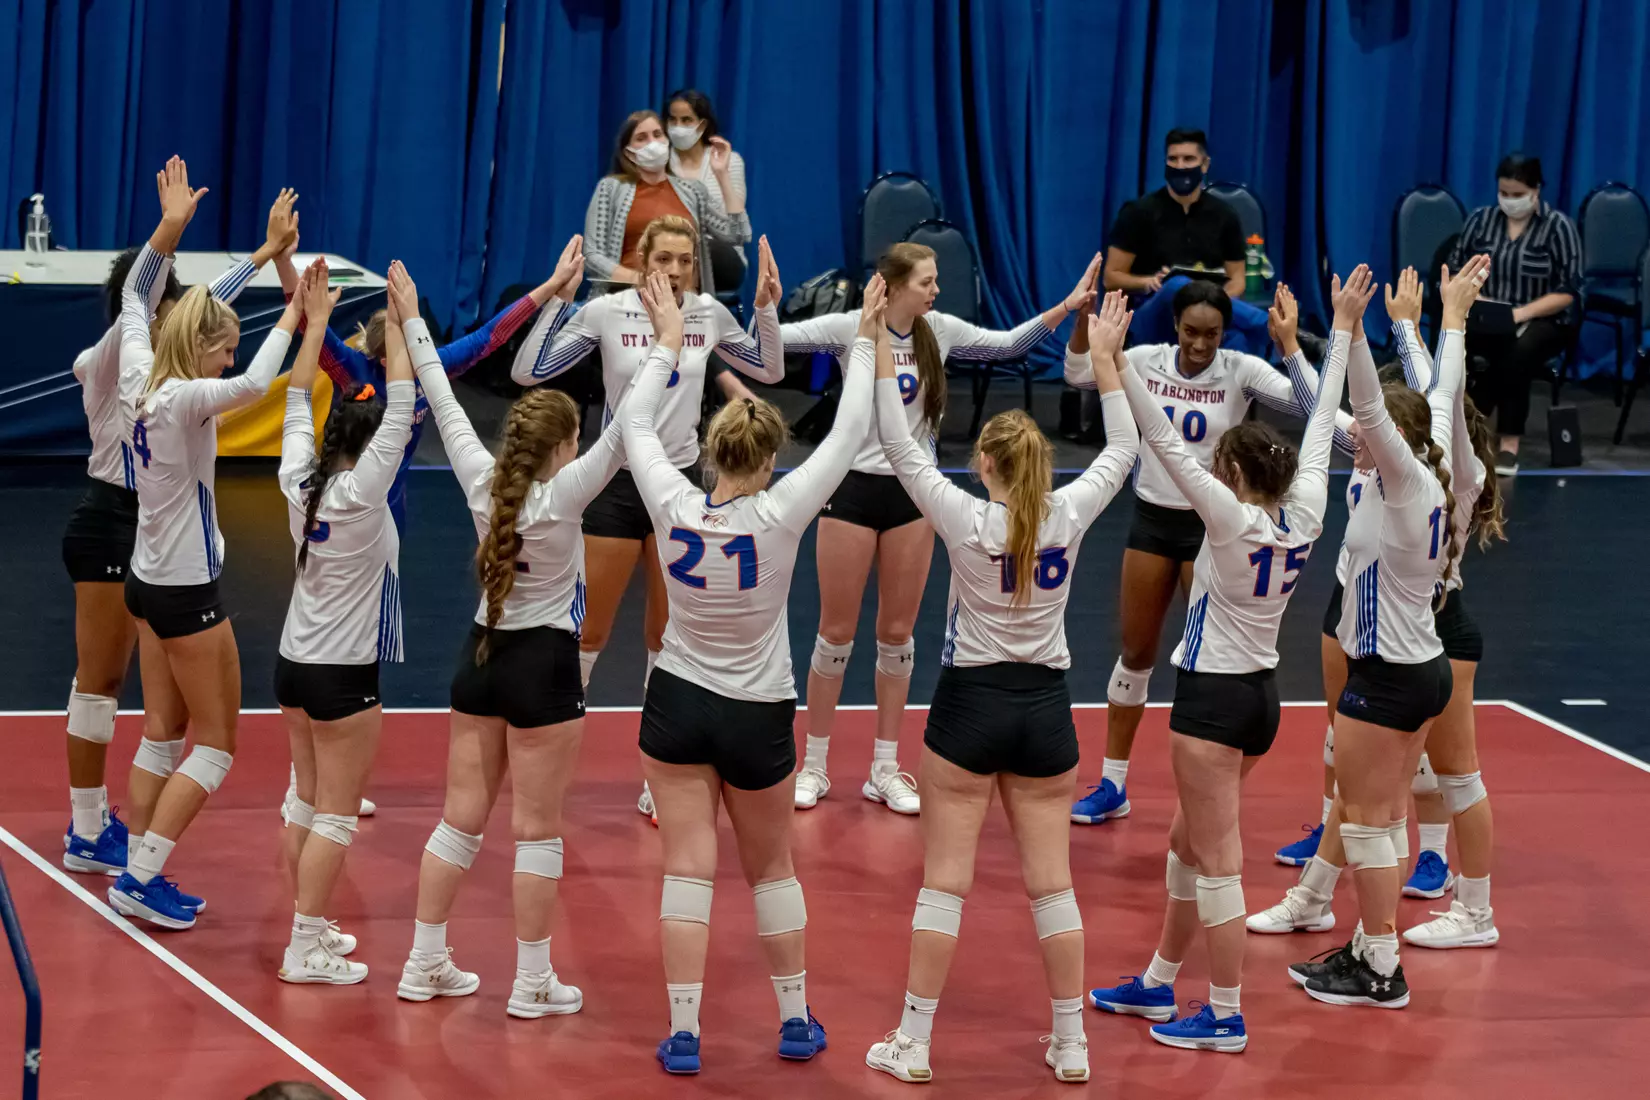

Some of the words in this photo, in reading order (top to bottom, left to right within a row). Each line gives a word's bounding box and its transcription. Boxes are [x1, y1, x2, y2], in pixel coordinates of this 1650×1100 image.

[621, 334, 638, 347] UT
[897, 373, 919, 406] 9
[1147, 378, 1161, 395] UT
[1161, 383, 1226, 404] ARLINGTON
[133, 419, 152, 470] 4
[667, 526, 759, 591] 21
[988, 546, 1069, 594] 16
[1248, 543, 1310, 597] 15
